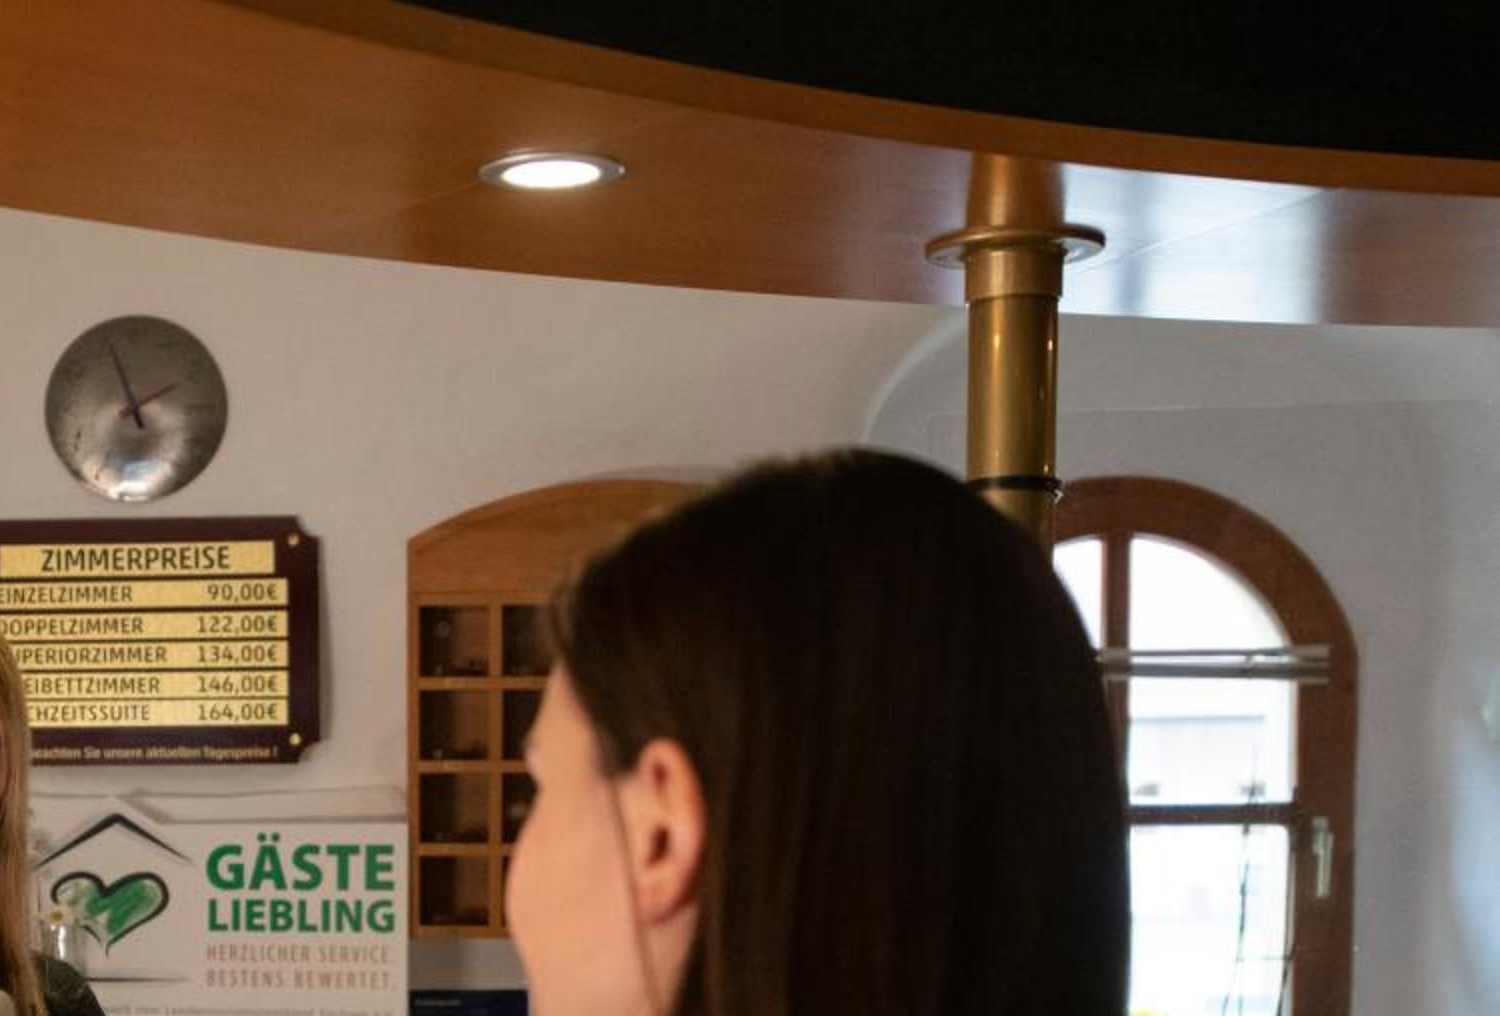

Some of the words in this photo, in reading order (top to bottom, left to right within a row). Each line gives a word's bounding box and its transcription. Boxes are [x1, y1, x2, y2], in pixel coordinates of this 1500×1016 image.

[41, 546, 229, 571] ZIMMERPREISE
[207, 583, 277, 602] 90,00€
[197, 615, 277, 635] 122,00€
[15, 645, 167, 665] PERIORZIMMER
[197, 645, 277, 664] 134,00€
[24, 676, 160, 695] EIBETTZIMMER
[197, 675, 278, 695] 146,00€
[28, 704, 150, 722] CHZEITSSUITE
[197, 703, 278, 722] 164,00€
[206, 832, 396, 891] GÄSTE
[208, 898, 396, 933] LIEBLING
[206, 944, 311, 963] HERZLICHER
[206, 969, 284, 988] BESTENS
